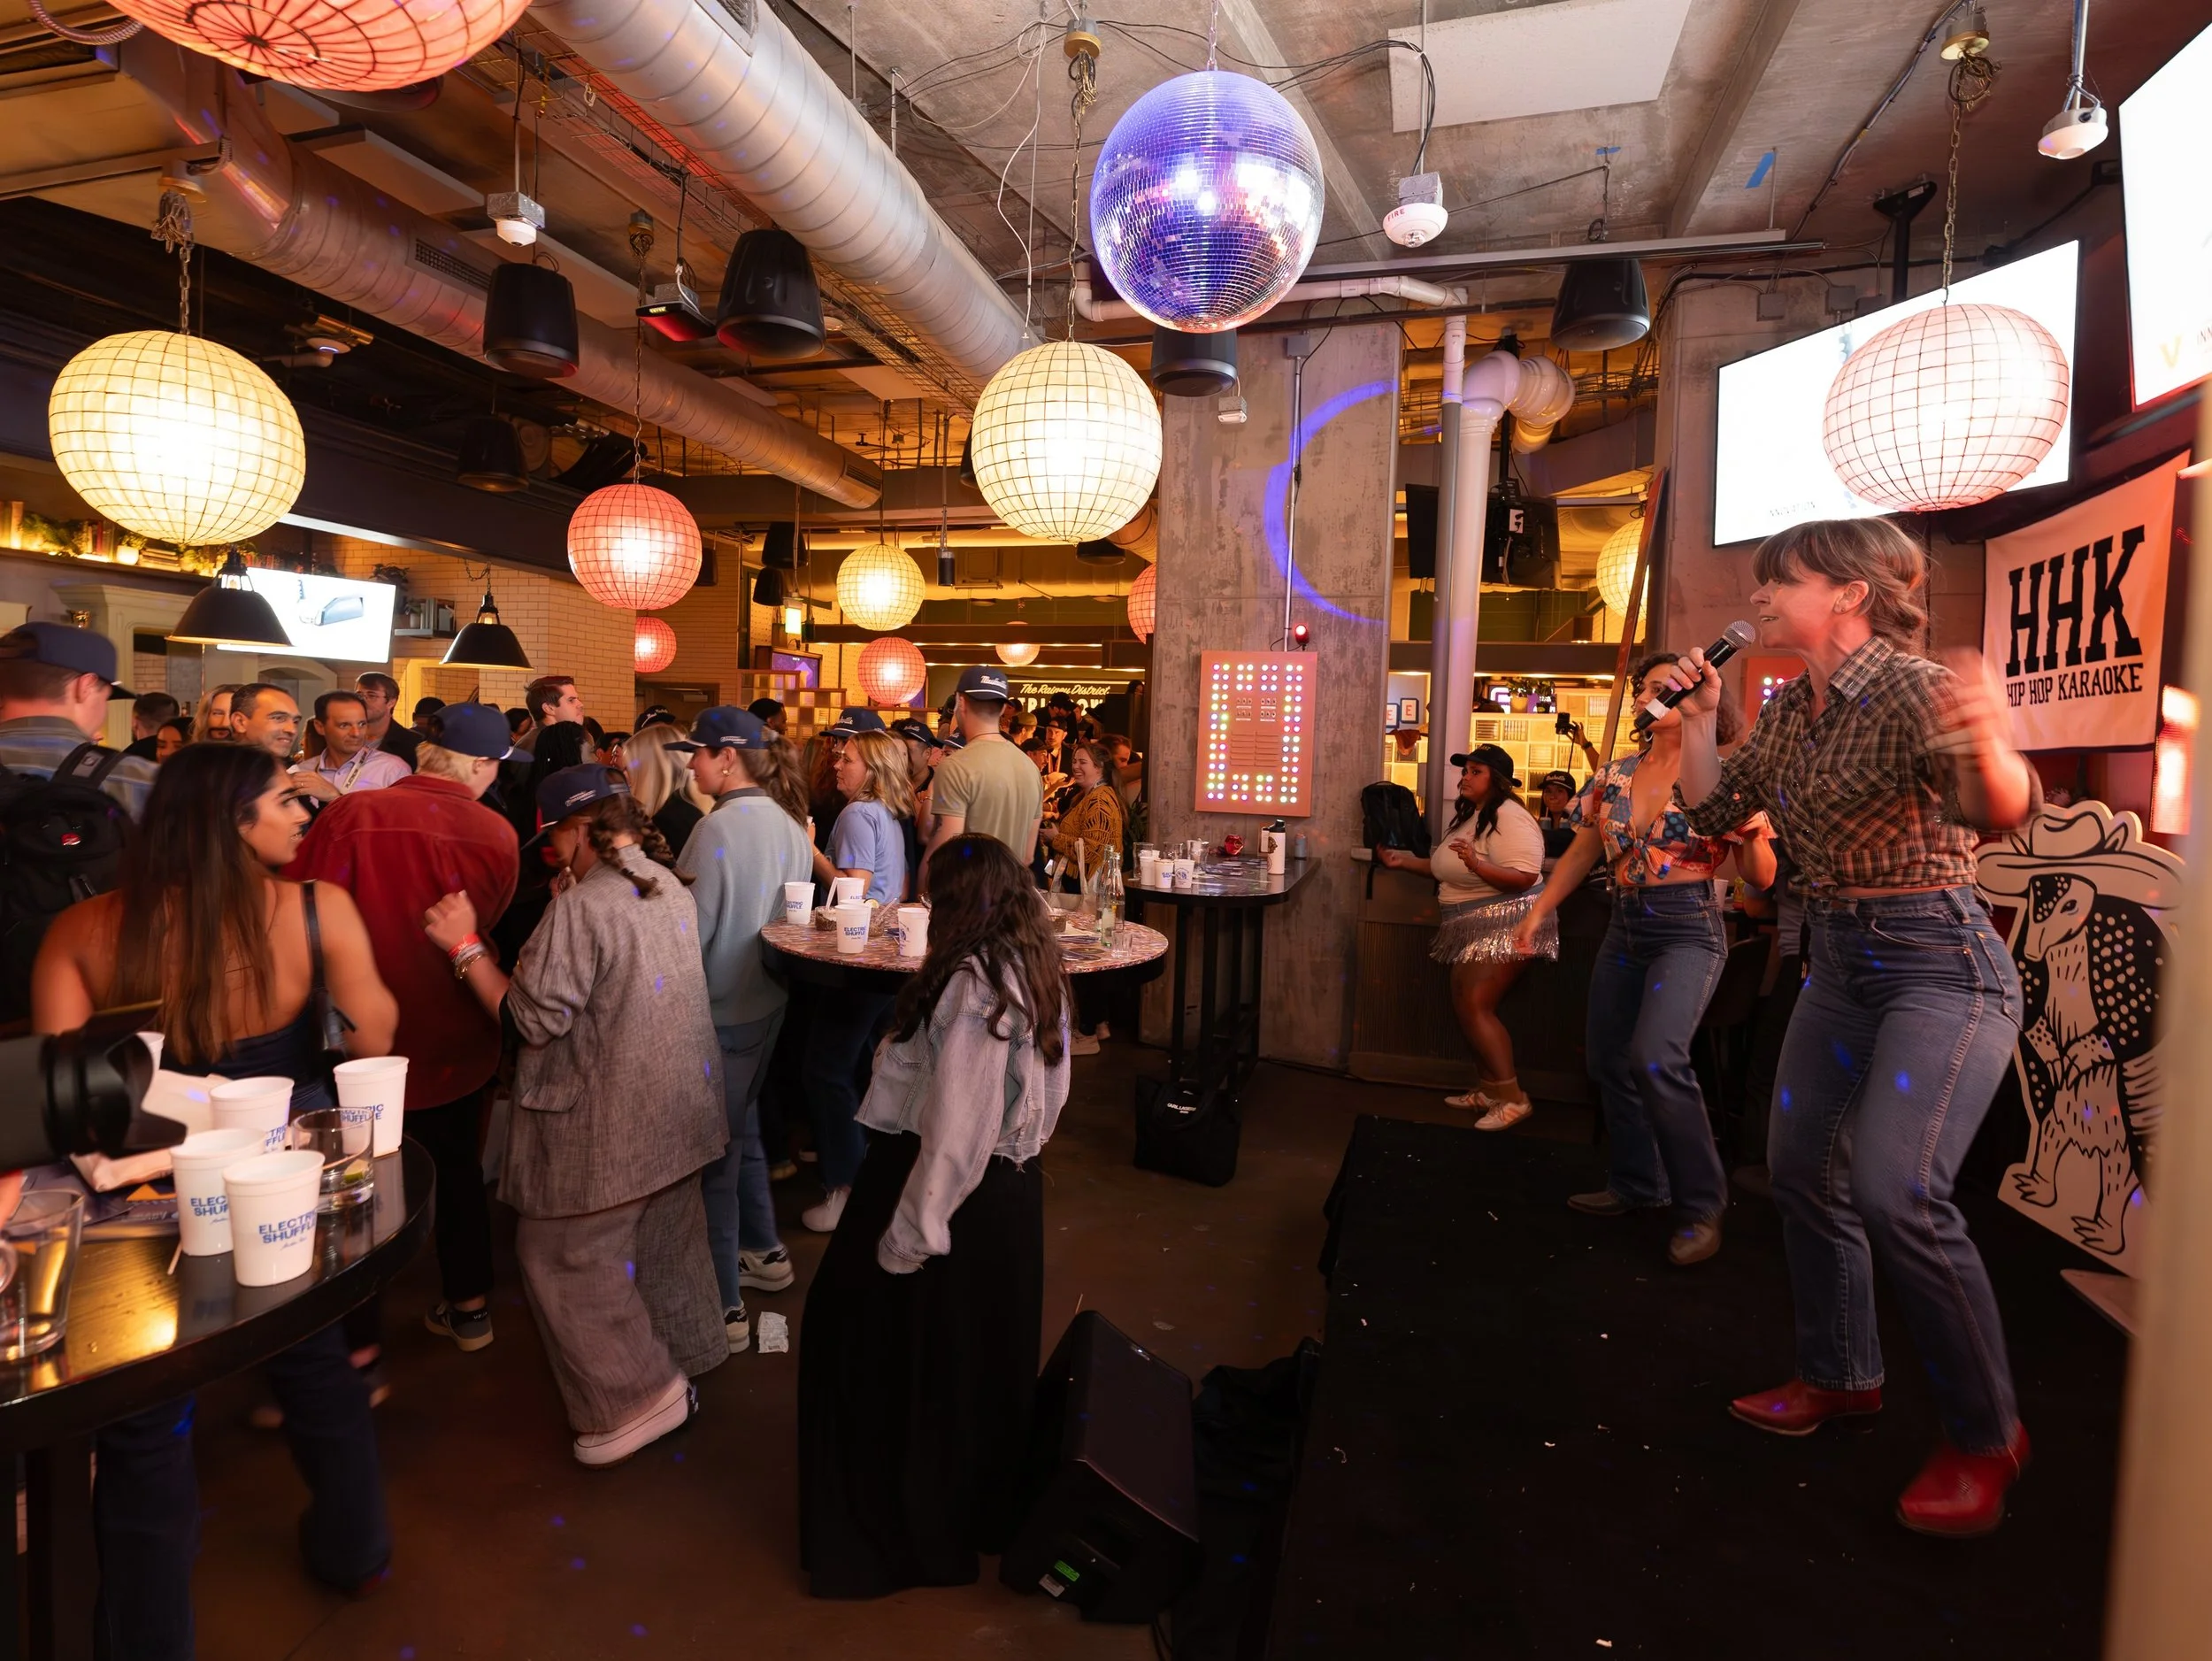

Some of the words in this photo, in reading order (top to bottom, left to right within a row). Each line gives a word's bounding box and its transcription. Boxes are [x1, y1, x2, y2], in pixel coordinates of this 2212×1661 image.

[1387, 208, 1406, 221] FIRE
[2006, 524, 2146, 678] HHK
[1020, 683, 1038, 694] The
[2007, 681, 2025, 707] HIP
[2029, 676, 2054, 705] HOP
[2058, 662, 2144, 701] KARAOKE
